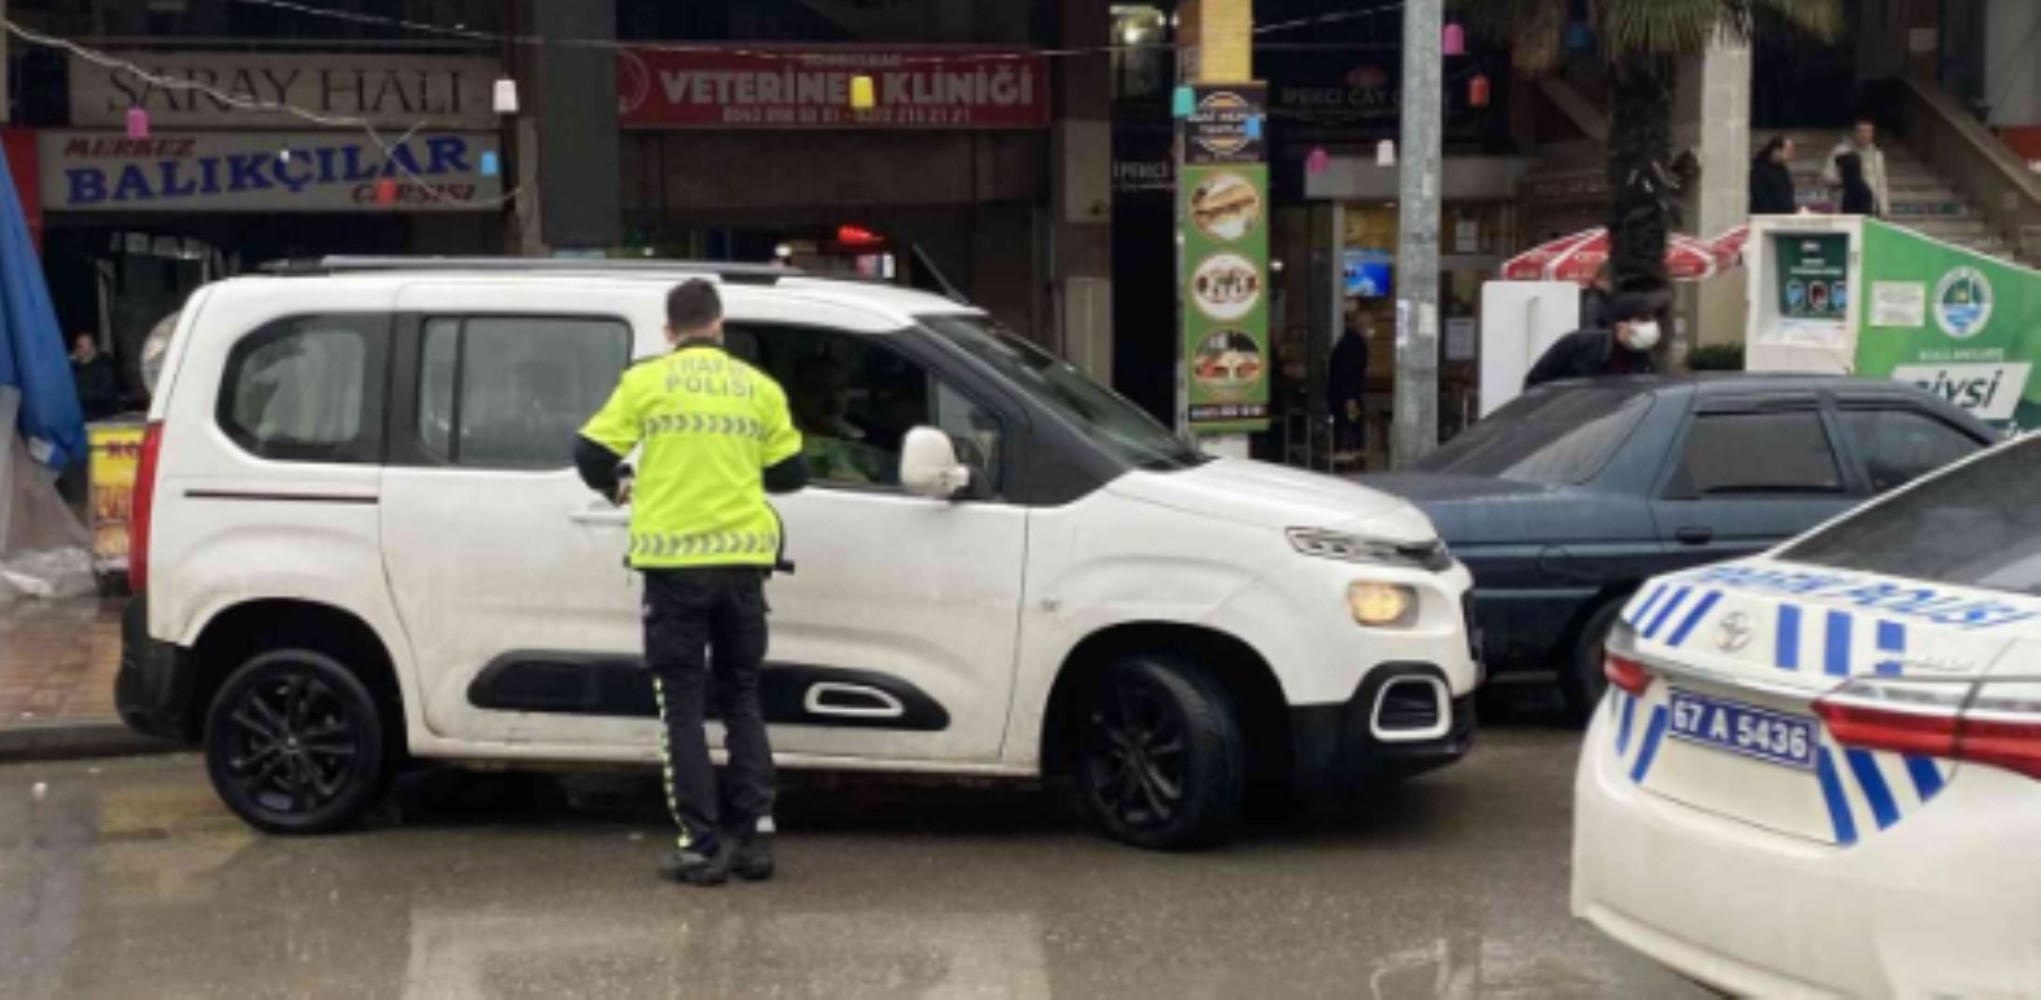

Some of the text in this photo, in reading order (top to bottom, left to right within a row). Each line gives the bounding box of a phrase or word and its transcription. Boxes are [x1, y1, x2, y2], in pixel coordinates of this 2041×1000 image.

[107, 67, 300, 114] SARAY
[658, 63, 875, 106] VETERİNE
[64, 134, 472, 205] BALIKÇILAR
[1673, 699, 1808, 758] 67 A 5436
